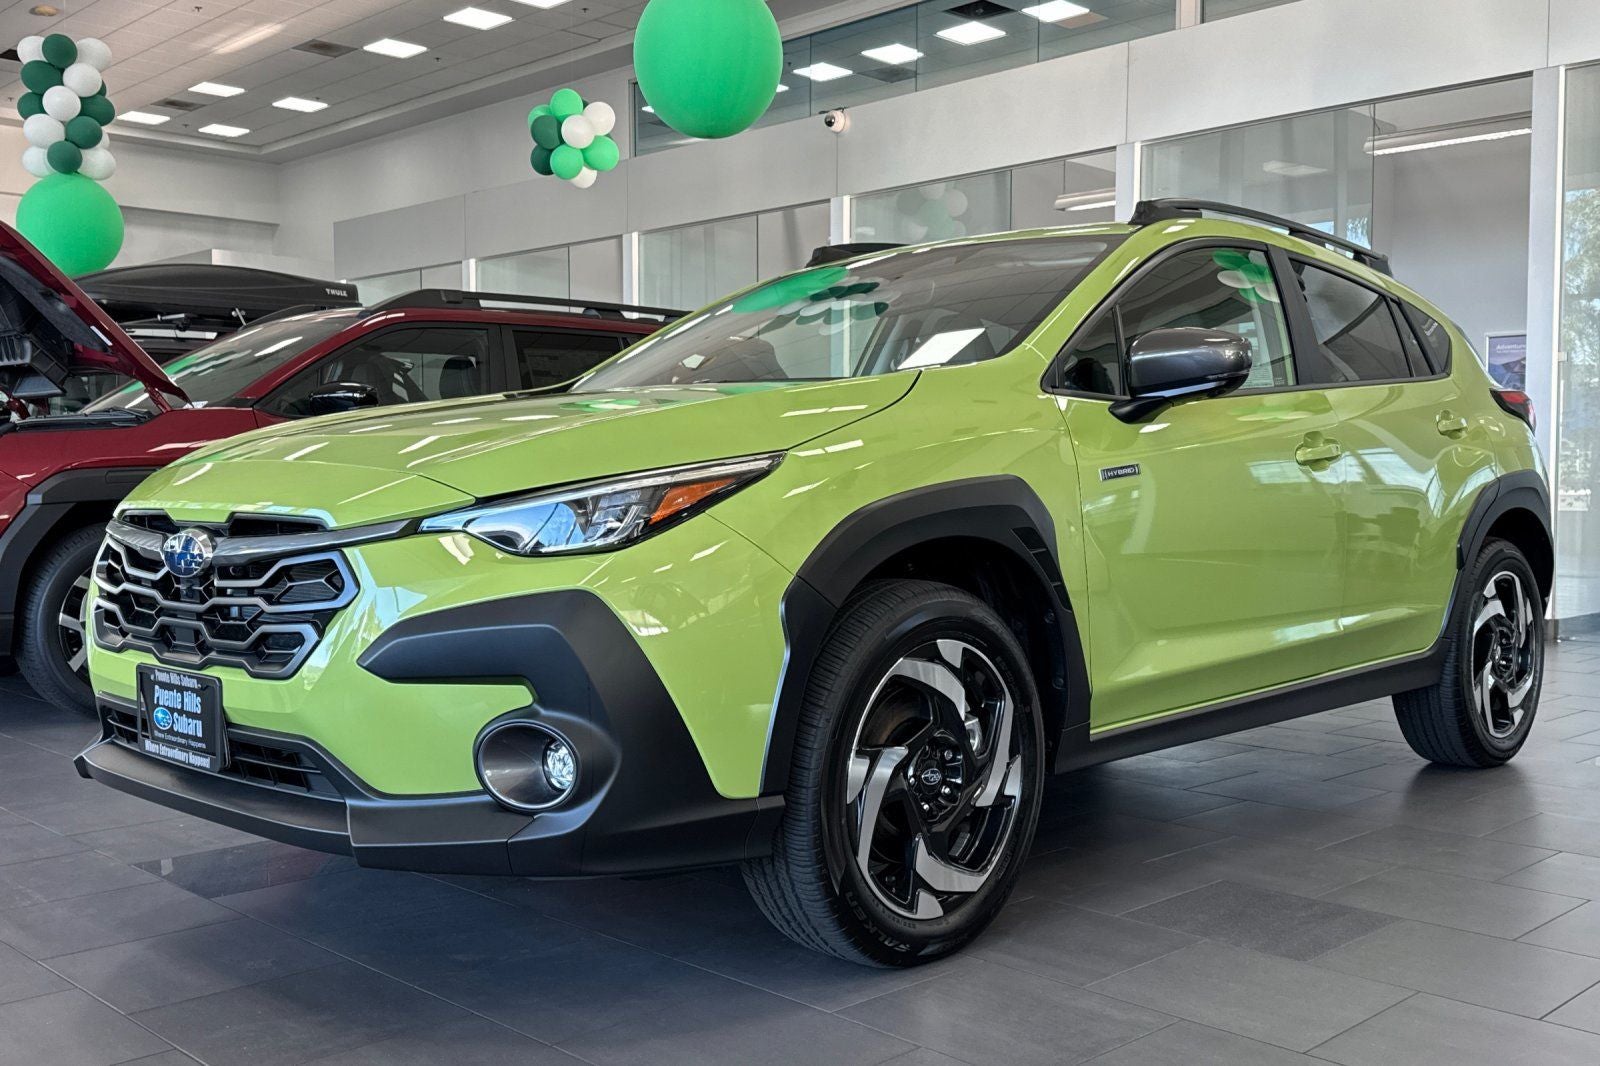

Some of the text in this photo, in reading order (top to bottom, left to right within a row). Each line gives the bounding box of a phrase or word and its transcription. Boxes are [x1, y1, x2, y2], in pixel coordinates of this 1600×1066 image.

[325, 288, 347, 297] THULE
[1107, 467, 1135, 476] HYBRID
[155, 669, 198, 688] Puente Hills Subaru
[154, 685, 202, 714] Puente Hills
[173, 712, 203, 738] Subaru
[144, 740, 159, 753] Where
[159, 743, 189, 764] Extraordinary
[845, 891, 911, 952] FALKEN
